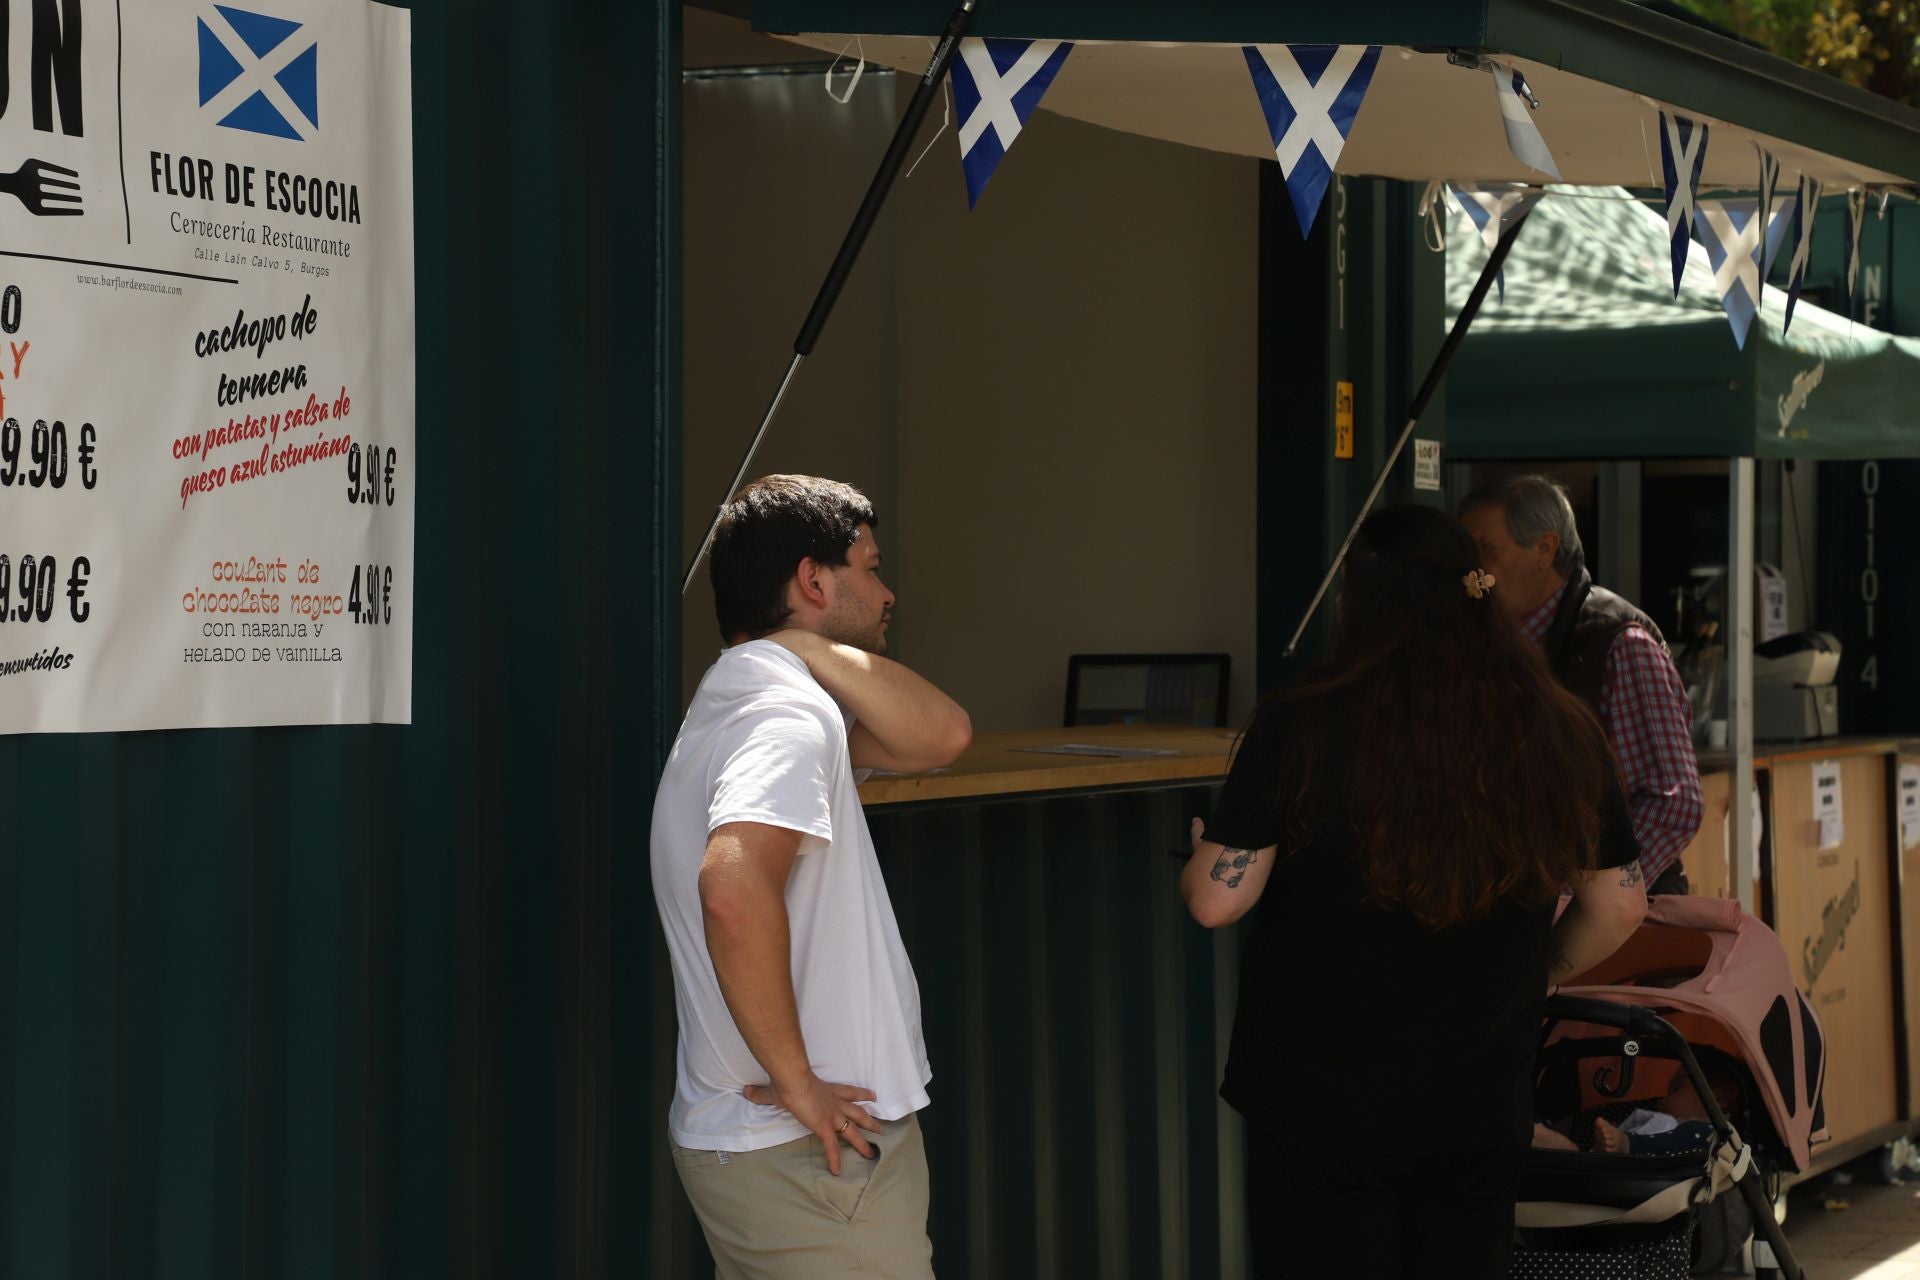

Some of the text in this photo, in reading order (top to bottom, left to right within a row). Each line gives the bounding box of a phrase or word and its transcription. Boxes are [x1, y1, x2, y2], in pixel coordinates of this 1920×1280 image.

[151, 151, 360, 224] FLOR DE ESCOCIA
[171, 212, 350, 257] Cervecería Restaurante
[195, 248, 219, 261] Calle
[252, 256, 279, 269] Calvo
[285, 260, 293, 272] 5,
[301, 262, 329, 277] Burgos
[78, 275, 183, 295] www.barflordeescocia.com
[195, 294, 317, 358] cachopo de
[218, 362, 308, 407] ternera
[0, 417, 97, 489] 9.90 €
[173, 386, 350, 462] con patatas y salsa de
[181, 467, 226, 510] queso
[229, 442, 270, 484] azul
[347, 442, 396, 506] 9.90 €
[67, 556, 90, 623] €
[213, 556, 319, 583] coulant de
[348, 564, 392, 625] 4.90 €
[183, 587, 342, 621] chocolate negro
[1860, 653, 1880, 690] 4
